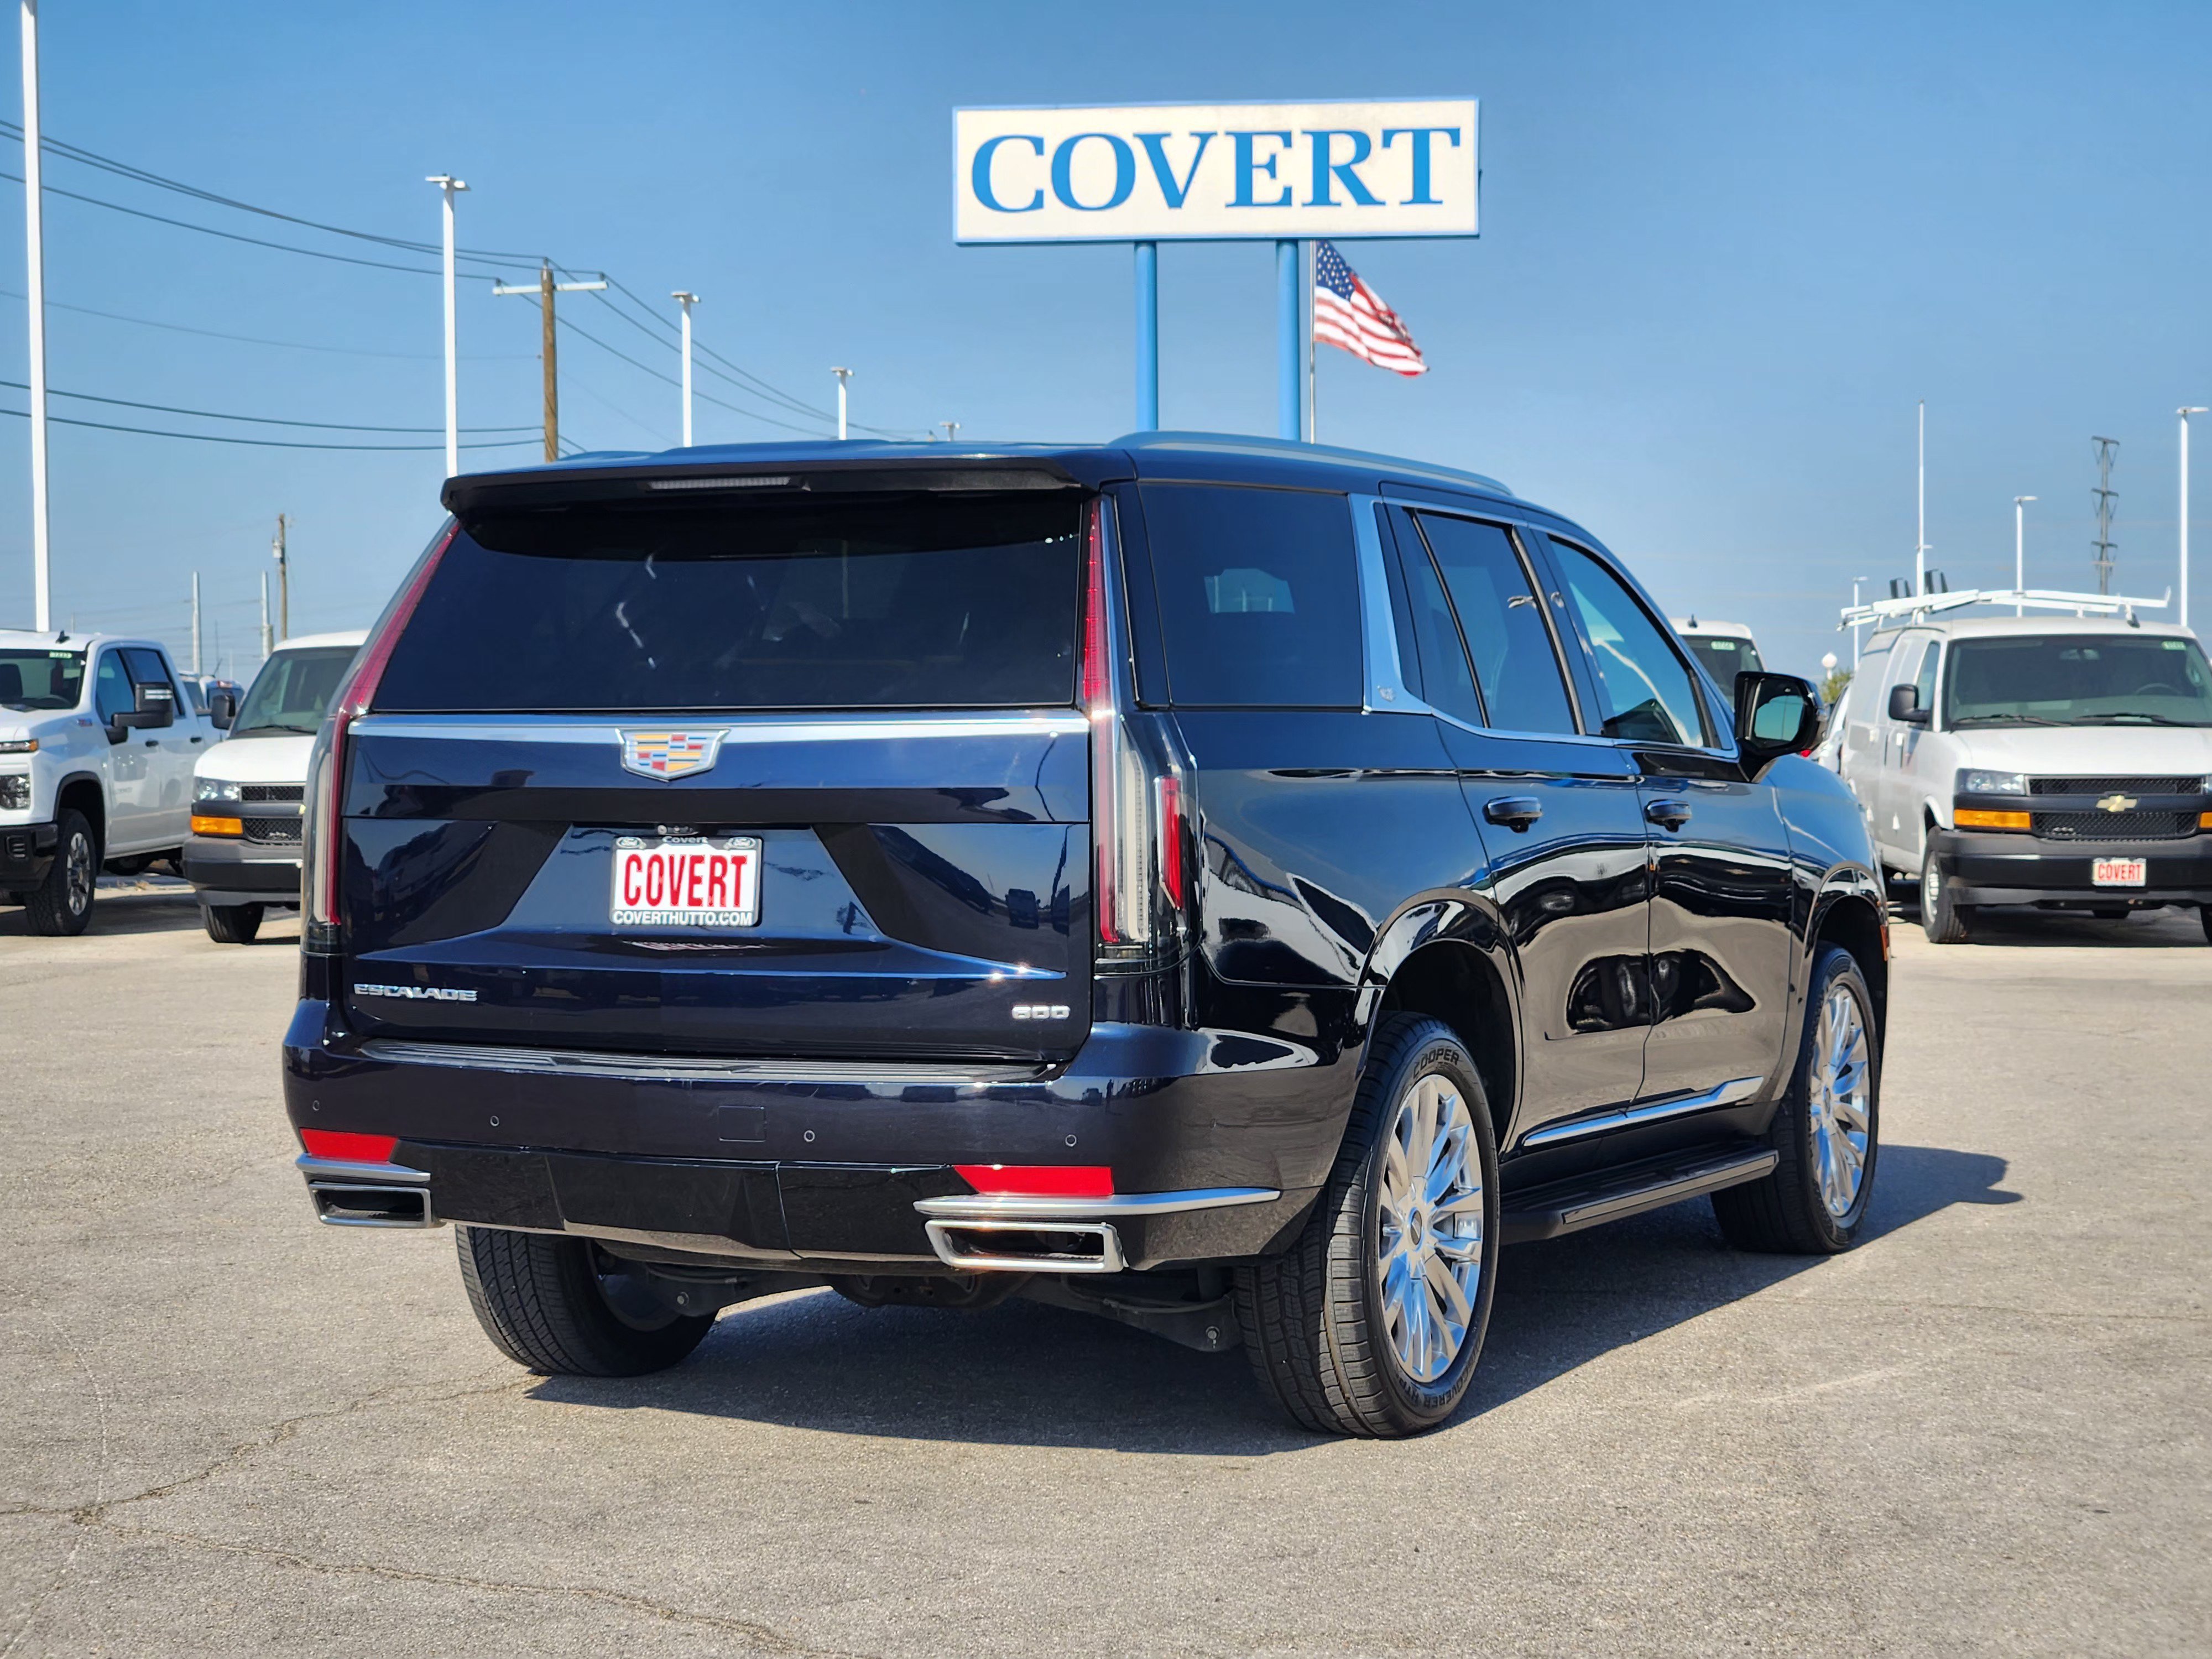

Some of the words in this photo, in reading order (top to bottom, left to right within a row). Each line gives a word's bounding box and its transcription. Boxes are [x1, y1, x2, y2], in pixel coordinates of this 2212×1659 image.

[971, 127, 1460, 213] COVERT
[624, 853, 748, 907] COVERT
[2098, 863, 2142, 881] COVERT
[613, 911, 753, 926] COVERTHUTTO.COM
[354, 983, 478, 1001] ESCALADE
[1011, 1005, 1071, 1019] 600
[1413, 1047, 1460, 1076] COOPER
